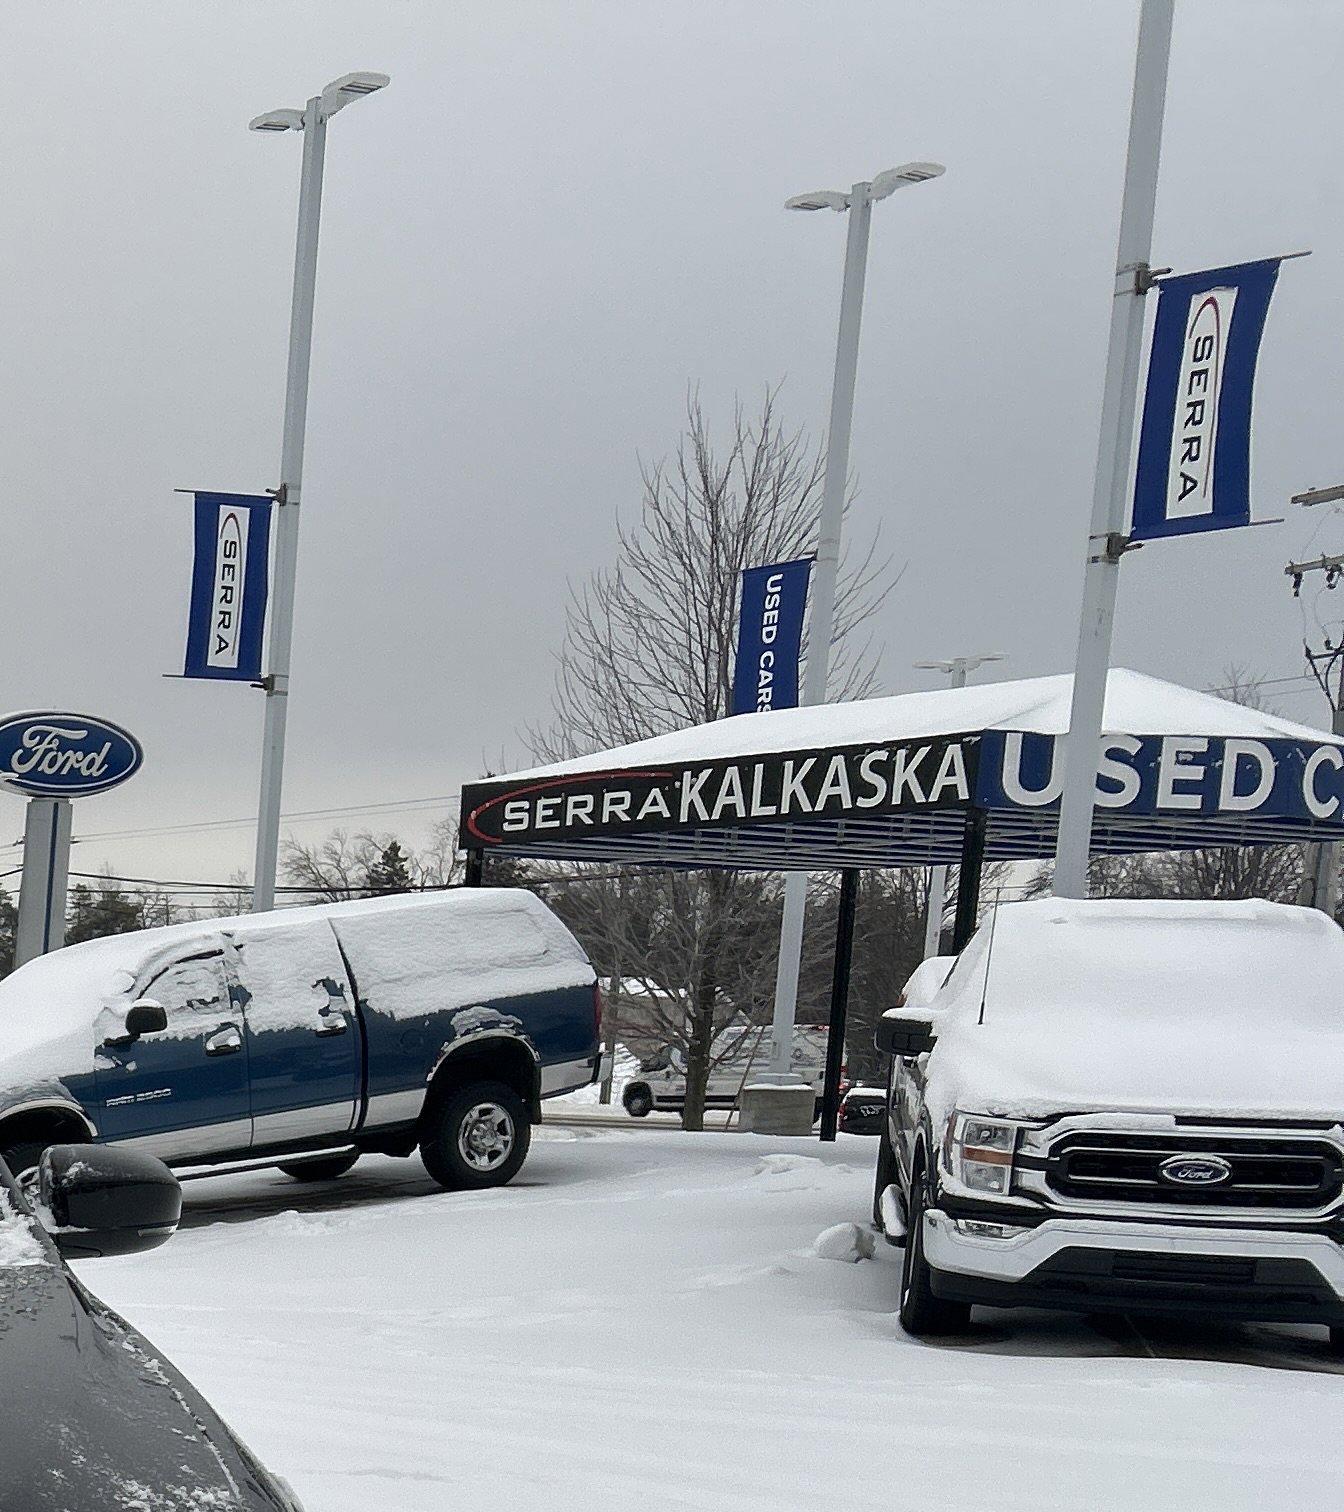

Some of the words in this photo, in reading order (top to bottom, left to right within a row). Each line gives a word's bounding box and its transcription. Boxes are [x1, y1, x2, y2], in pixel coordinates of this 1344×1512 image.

[1177, 334, 1214, 502] SERRA
[215, 539, 238, 655] SERRA
[762, 573, 784, 645] USED
[11, 725, 112, 777] Ford
[502, 787, 671, 831] SERRA
[679, 743, 970, 823] KALKASKA
[1002, 732, 1276, 812] USED
[1178, 1165, 1214, 1179] Ford
